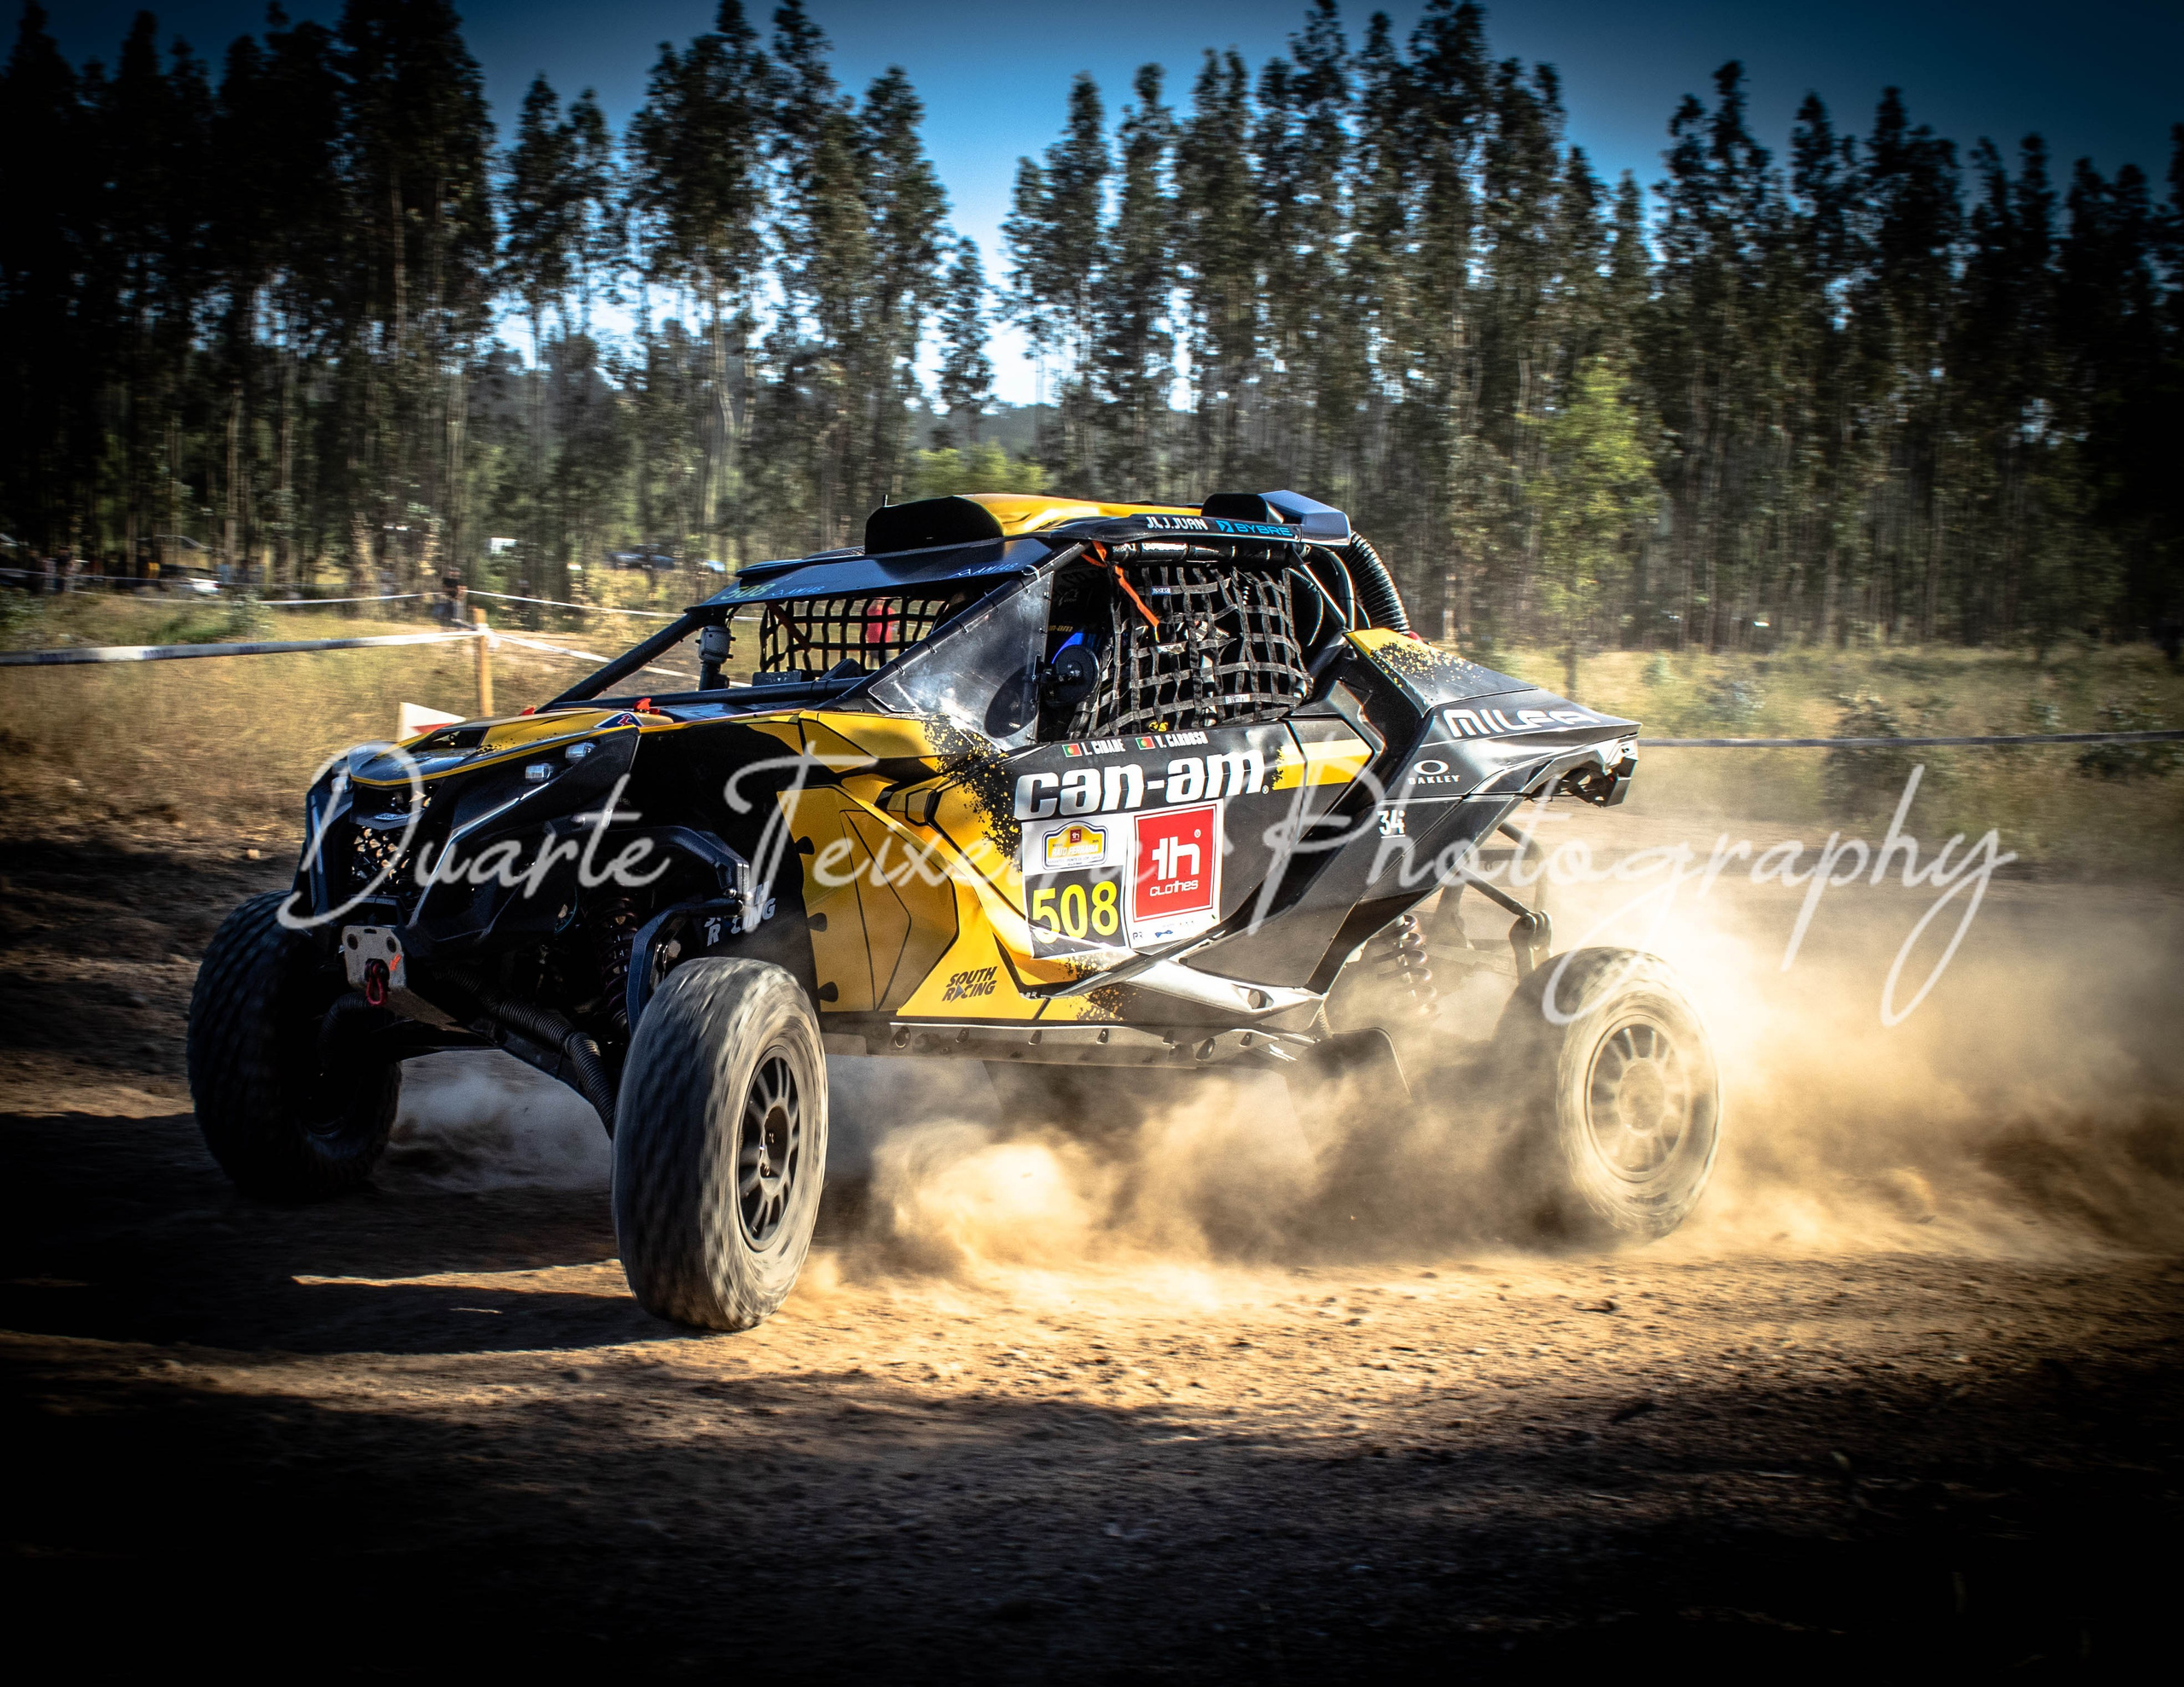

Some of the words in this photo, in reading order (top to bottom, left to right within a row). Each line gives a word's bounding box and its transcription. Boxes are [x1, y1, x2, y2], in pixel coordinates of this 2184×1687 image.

[1234, 523, 1293, 536] BYBRE
[1080, 742, 1093, 756] L.
[1014, 750, 1265, 820] can-am
[1408, 774, 1461, 785] OAKLEY
[1032, 881, 1119, 944] 508
[946, 966, 997, 988] SOUTH
